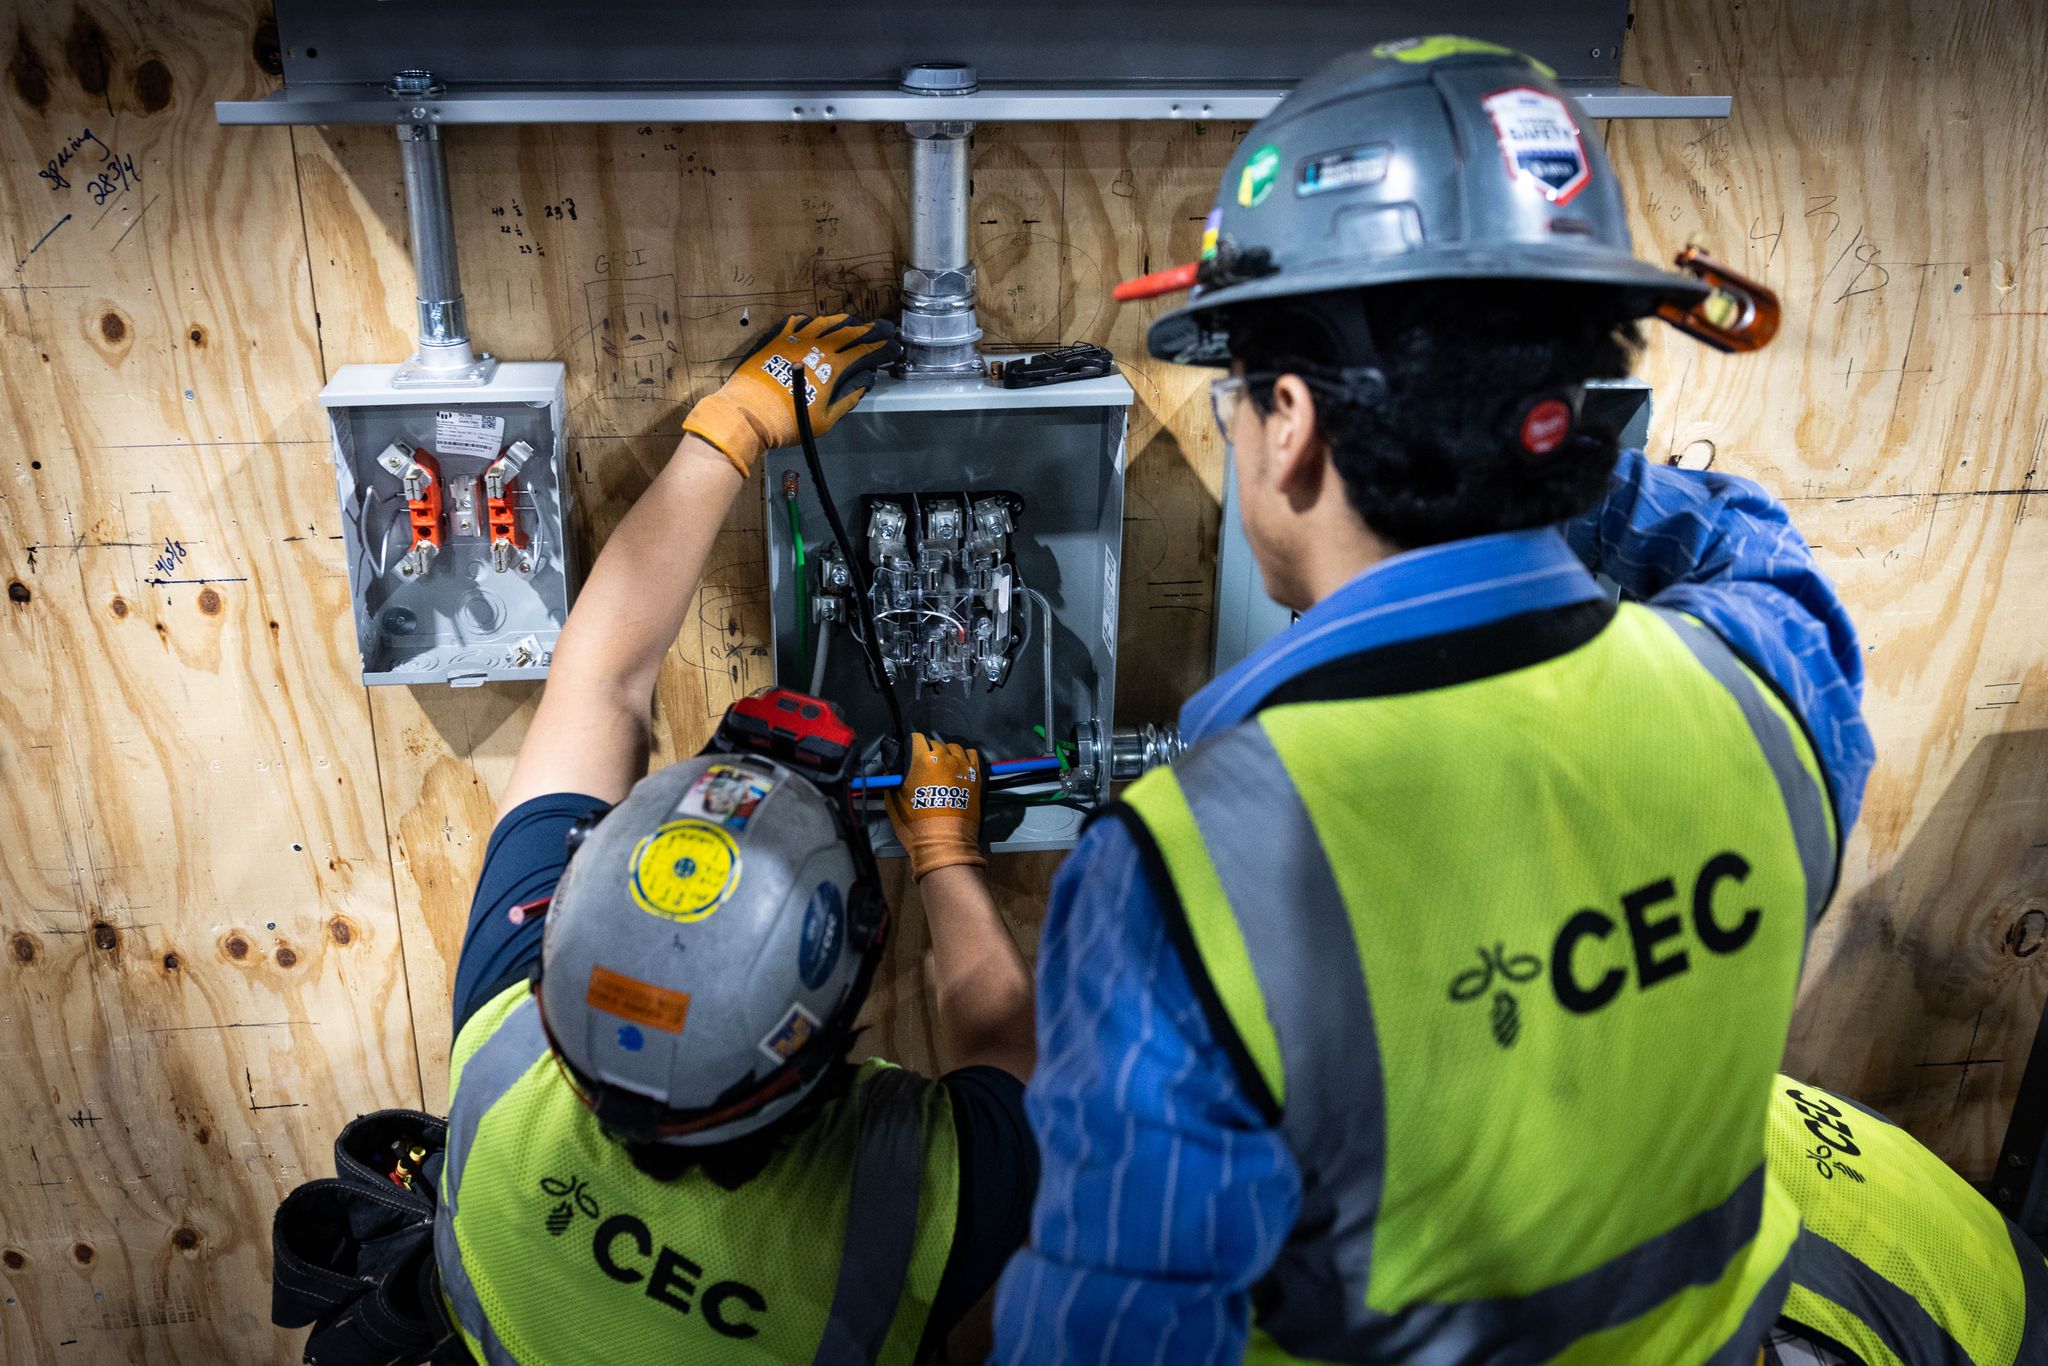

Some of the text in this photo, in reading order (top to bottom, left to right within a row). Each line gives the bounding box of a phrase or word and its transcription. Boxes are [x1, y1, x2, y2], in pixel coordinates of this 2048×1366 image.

[913, 797, 968, 809] KLEIN
[915, 786, 969, 799] TOOLS
[1551, 851, 1762, 1015] CEC
[1786, 1089, 1861, 1156] CEC
[593, 1213, 768, 1339] CEC
